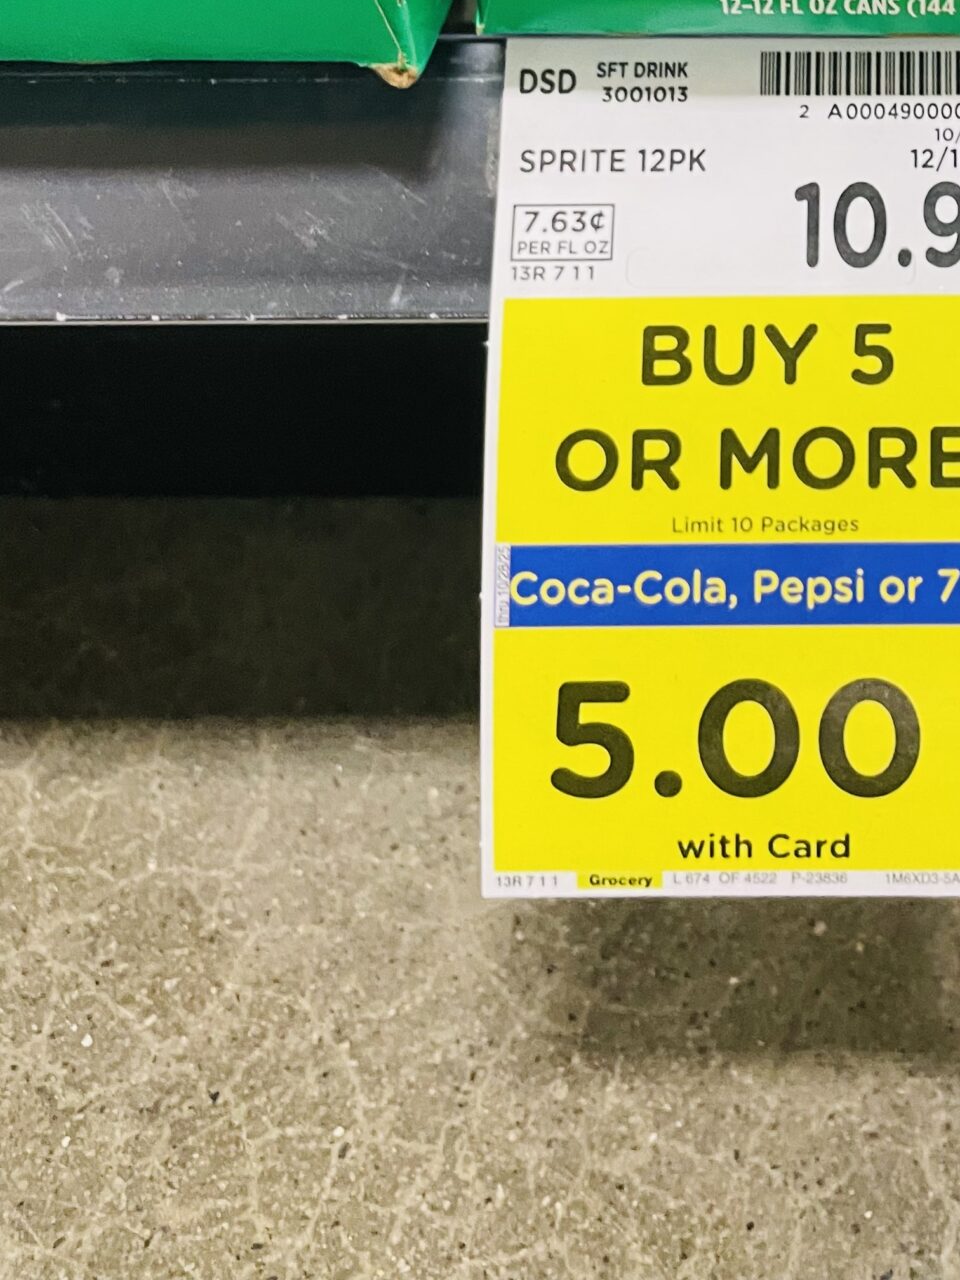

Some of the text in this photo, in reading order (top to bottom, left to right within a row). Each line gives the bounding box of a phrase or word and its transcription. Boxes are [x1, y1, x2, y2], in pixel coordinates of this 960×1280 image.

[518, 67, 577, 94] DSD
[596, 61, 689, 79] SFT DRINK
[602, 86, 689, 103] 3001013
[799, 104, 810, 119] 2
[519, 148, 707, 173] SPRITE 12PK
[524, 210, 605, 233] 7.63¢
[516, 241, 609, 255] PER FL OZ
[511, 266, 546, 281] 13R
[641, 323, 895, 387] BUY 5
[554, 427, 682, 492] OR
[672, 516, 859, 536] Limit 10 Packages
[508, 569, 738, 609] Coca-Cola,
[753, 568, 865, 610] Pepsi
[879, 575, 923, 604] or
[550, 677, 921, 800] 5.00
[677, 832, 851, 859] with Card
[589, 874, 653, 888] Grocery
[718, 872, 739, 884] OF
[744, 872, 778, 884] 4522
